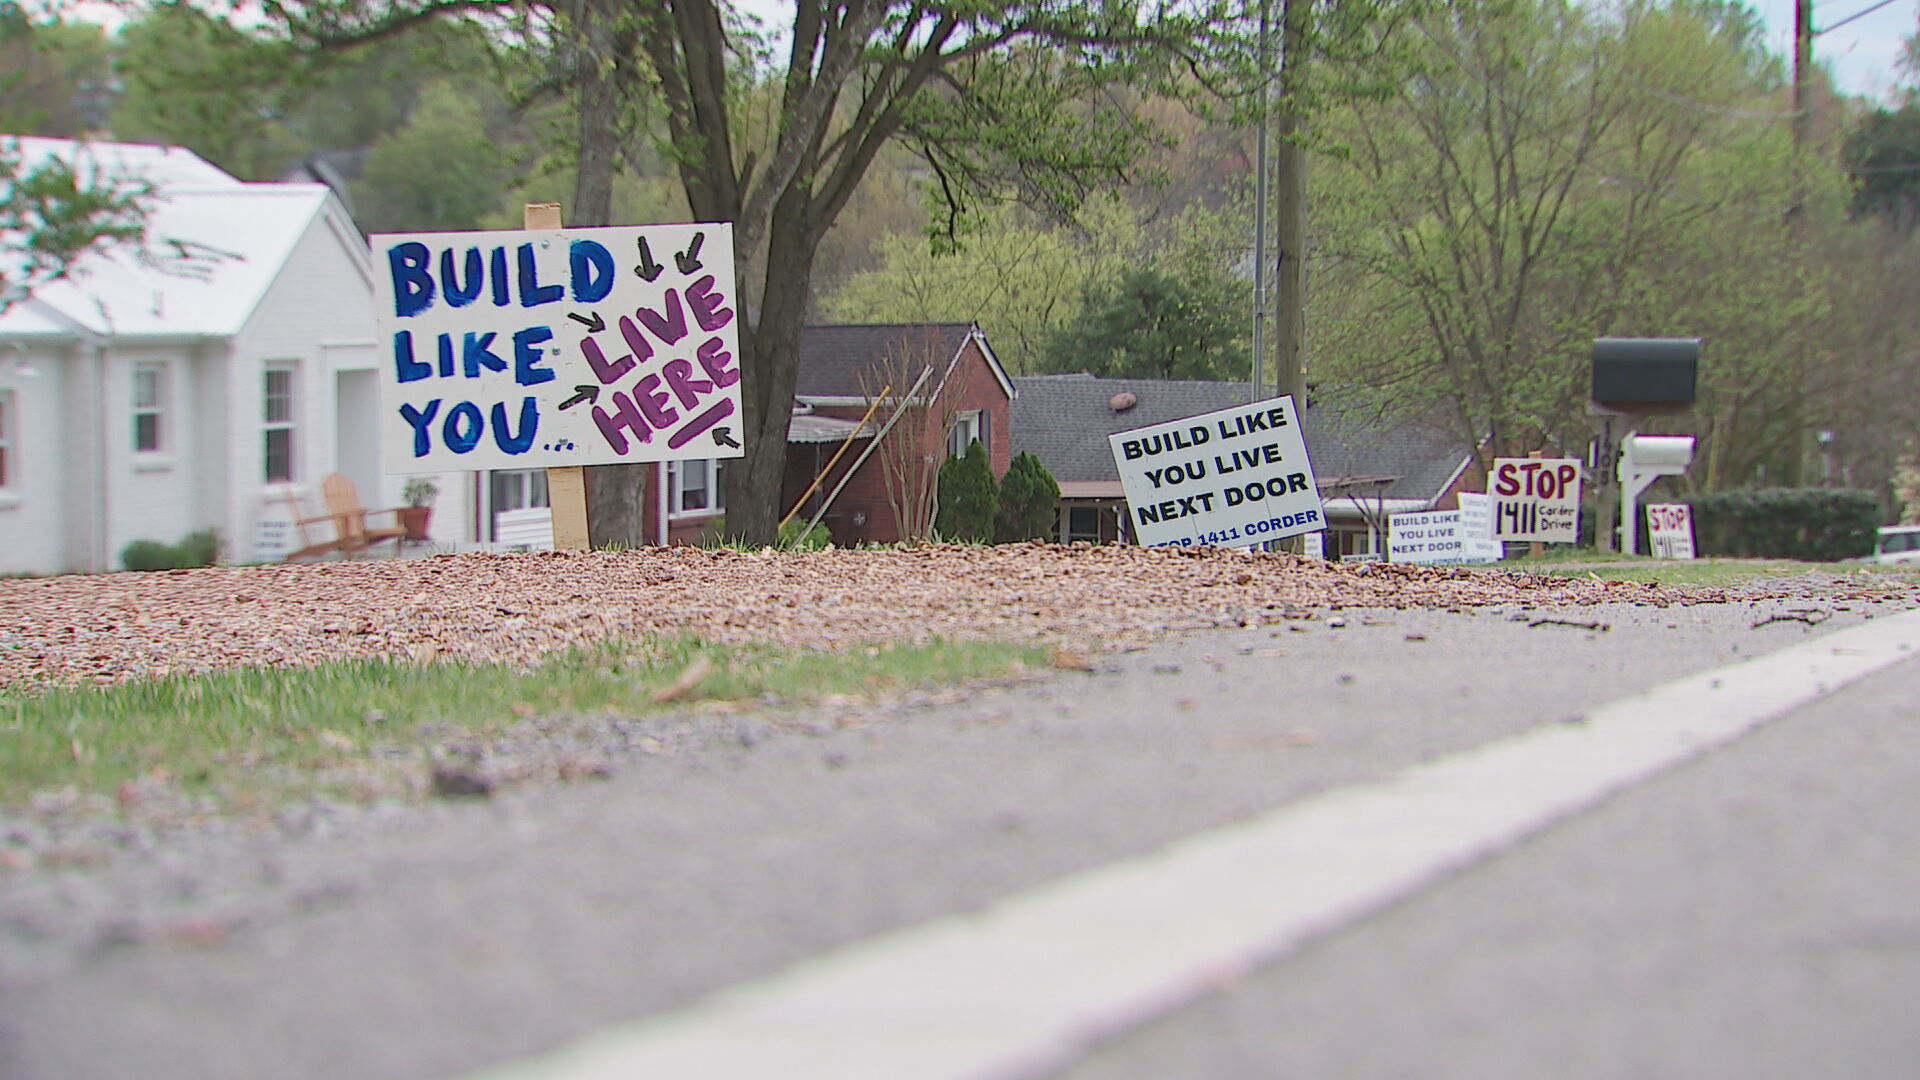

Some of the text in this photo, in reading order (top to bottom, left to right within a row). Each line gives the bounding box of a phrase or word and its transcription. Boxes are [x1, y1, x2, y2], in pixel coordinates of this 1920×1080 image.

[388, 239, 616, 317] BUILD
[580, 275, 734, 384] LIVE
[394, 326, 556, 386] LIKE
[592, 336, 740, 455] HERE
[1122, 407, 1288, 461] BUILD LIKE
[1144, 443, 1283, 489] YOU LIVE
[1495, 463, 1576, 499] STOP
[1137, 472, 1309, 526] NEXT DOOR
[1496, 501, 1536, 534] 1411
[1198, 528, 1241, 547] 1411
[1244, 510, 1319, 536] CORDER
[1393, 516, 1429, 527] BUILD
[1433, 514, 1460, 524] LIKE
[1400, 530, 1424, 540] YOU
[1428, 528, 1455, 538] LIVE
[1541, 518, 1573, 531] Drive
[1651, 508, 1685, 531] STOP
[1392, 541, 1462, 554] NEXT DOOR
